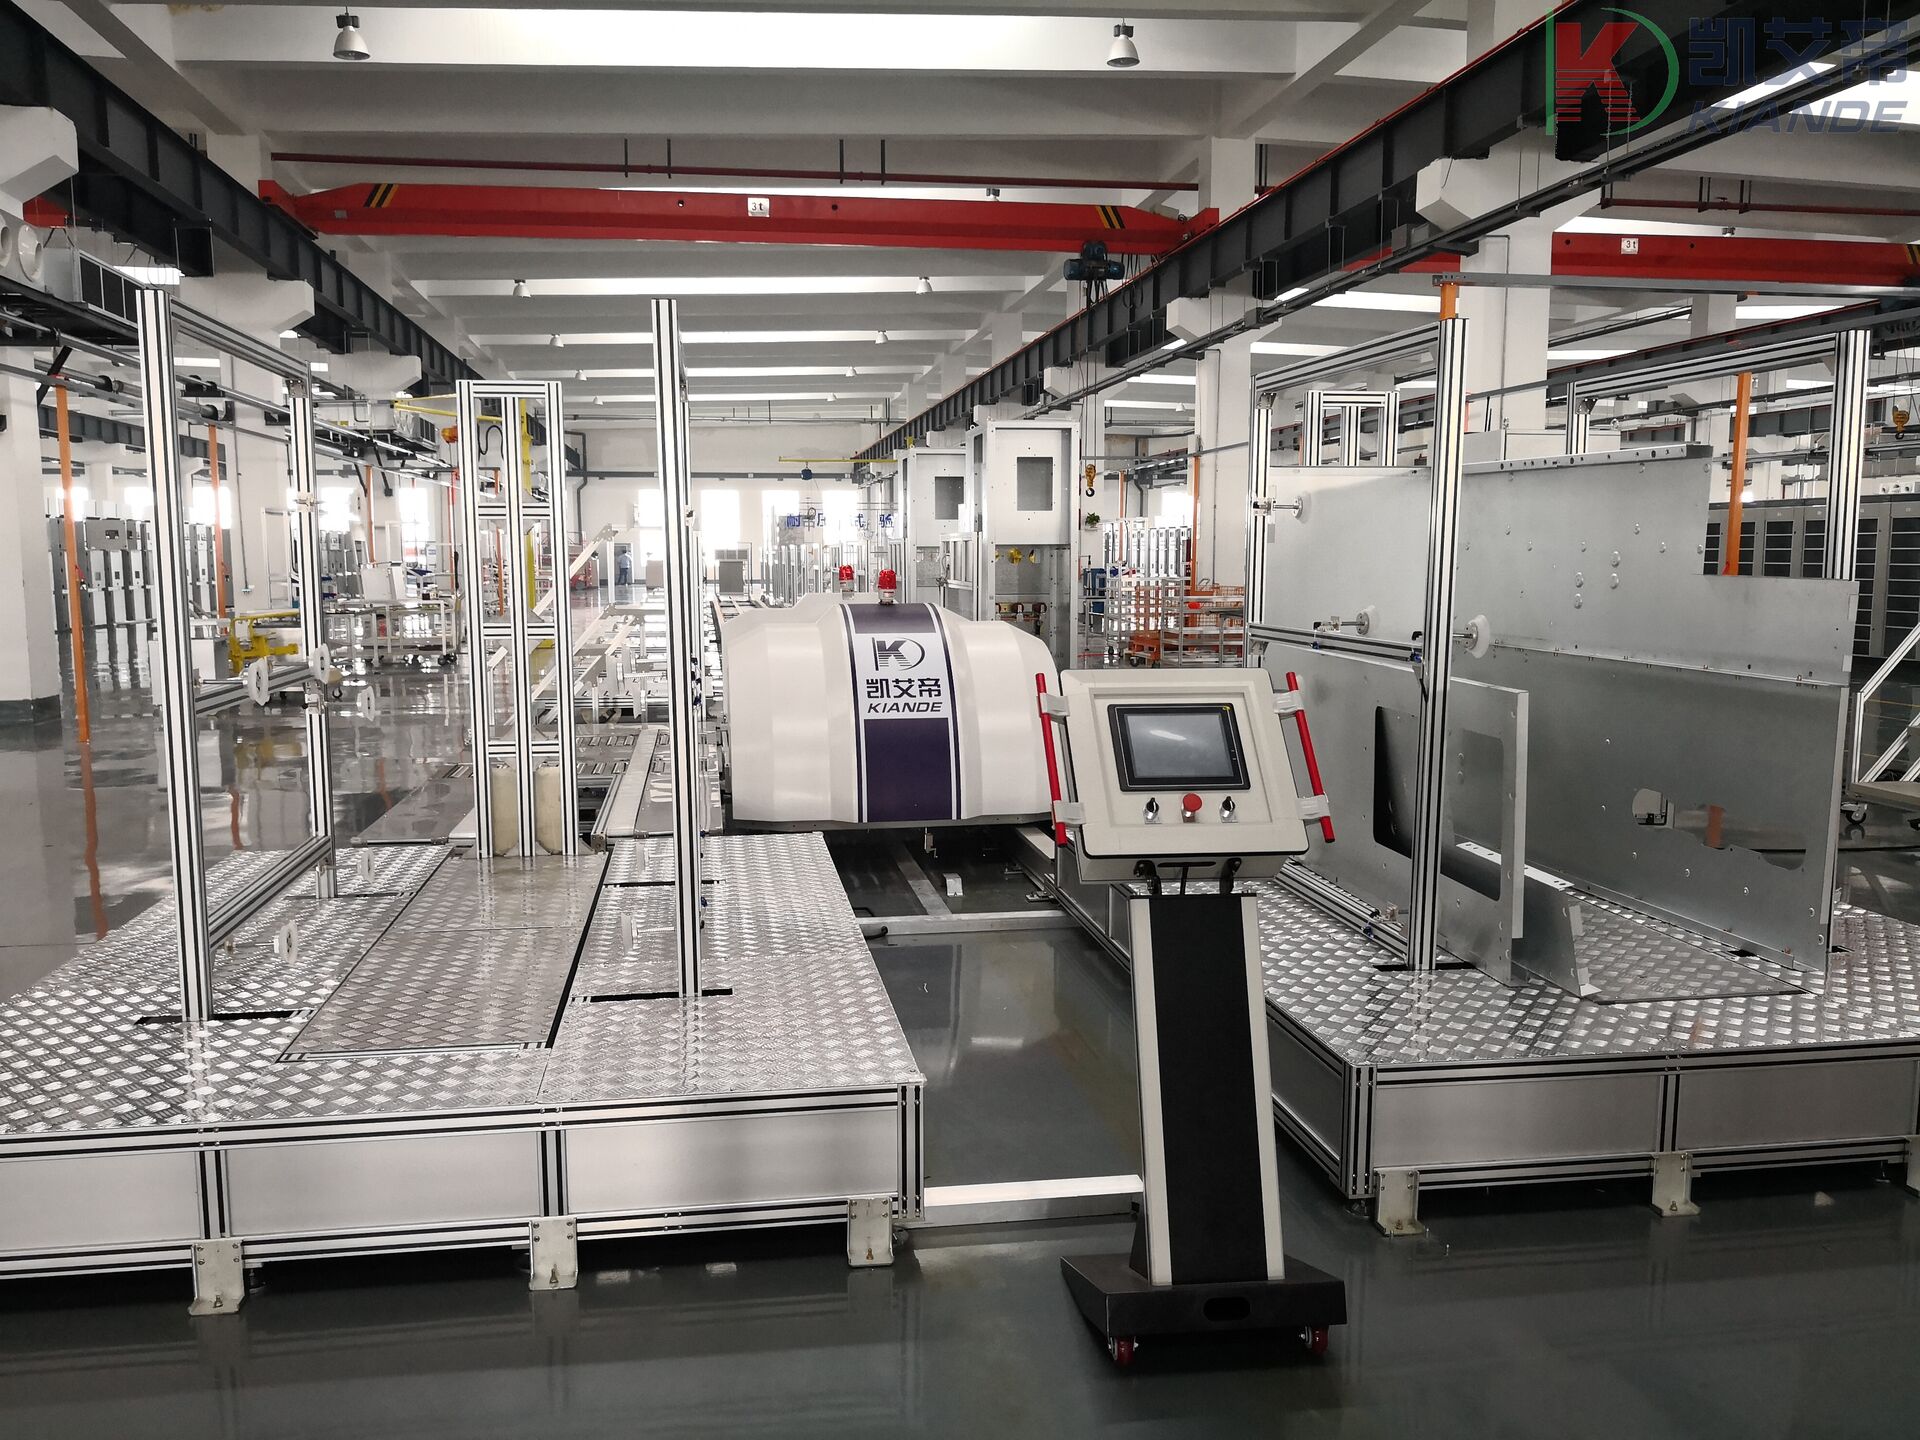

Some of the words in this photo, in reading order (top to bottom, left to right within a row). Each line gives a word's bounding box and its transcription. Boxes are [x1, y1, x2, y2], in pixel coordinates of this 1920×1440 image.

[865, 677, 942, 699] 凯艾帝
[867, 701, 943, 714] KIANDE
